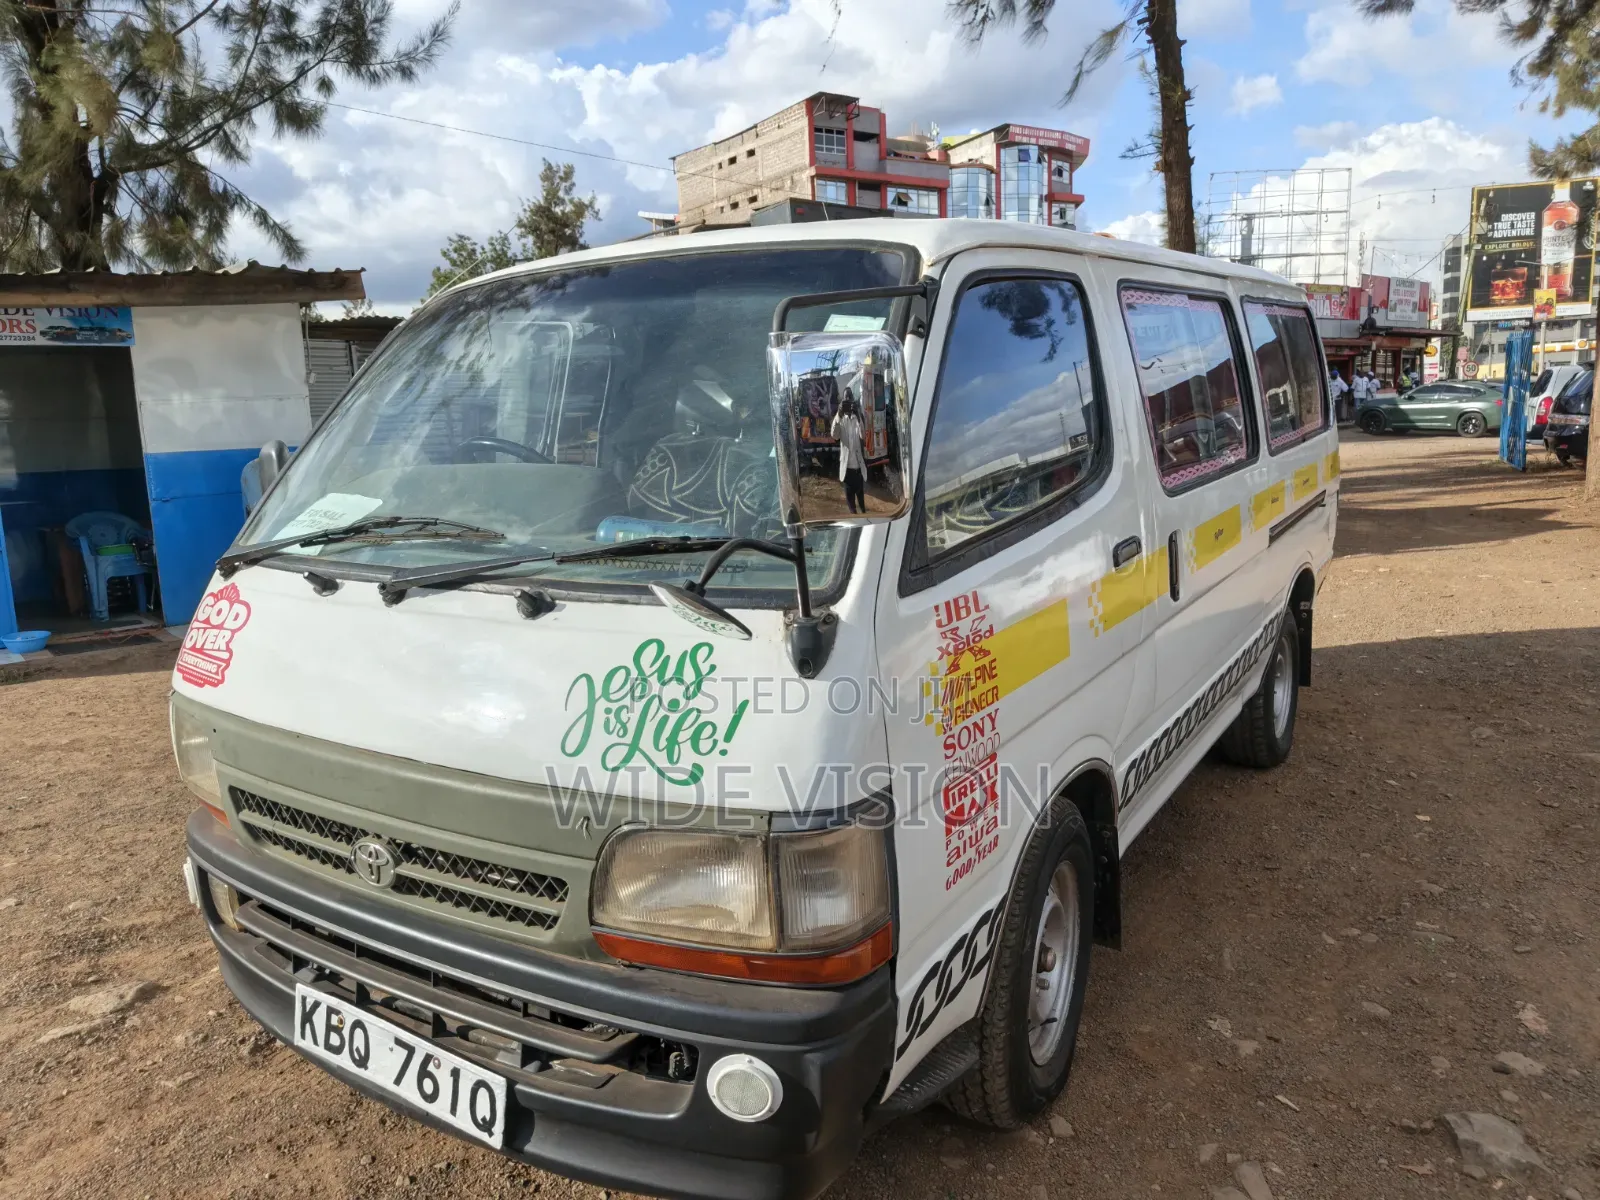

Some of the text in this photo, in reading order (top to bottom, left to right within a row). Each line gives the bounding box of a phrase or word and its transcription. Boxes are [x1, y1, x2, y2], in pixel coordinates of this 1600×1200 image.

[1493, 221, 1512, 230] TRUE
[1512, 220, 1535, 229] TASTE
[1493, 228, 1535, 238] ADVENTURE
[1501, 212, 1536, 221] DISCOVER
[1485, 242, 1510, 250] EXPLORE
[1465, 364, 1476, 372] 50
[197, 595, 248, 630] GOD
[934, 590, 990, 628] JBL
[185, 628, 232, 651] OVER
[182, 653, 218, 673] EVERYTHING
[560, 638, 717, 757] Jesus
[601, 694, 749, 786] is Life!
[943, 708, 1000, 760] SONY
[944, 732, 1000, 782] KENWOOD
[942, 752, 998, 814] PIRELLI
[944, 779, 999, 838] MAX
[945, 803, 999, 851] POWER
[945, 815, 999, 868] aiwa
[300, 995, 498, 1138] KBQ 761Q
